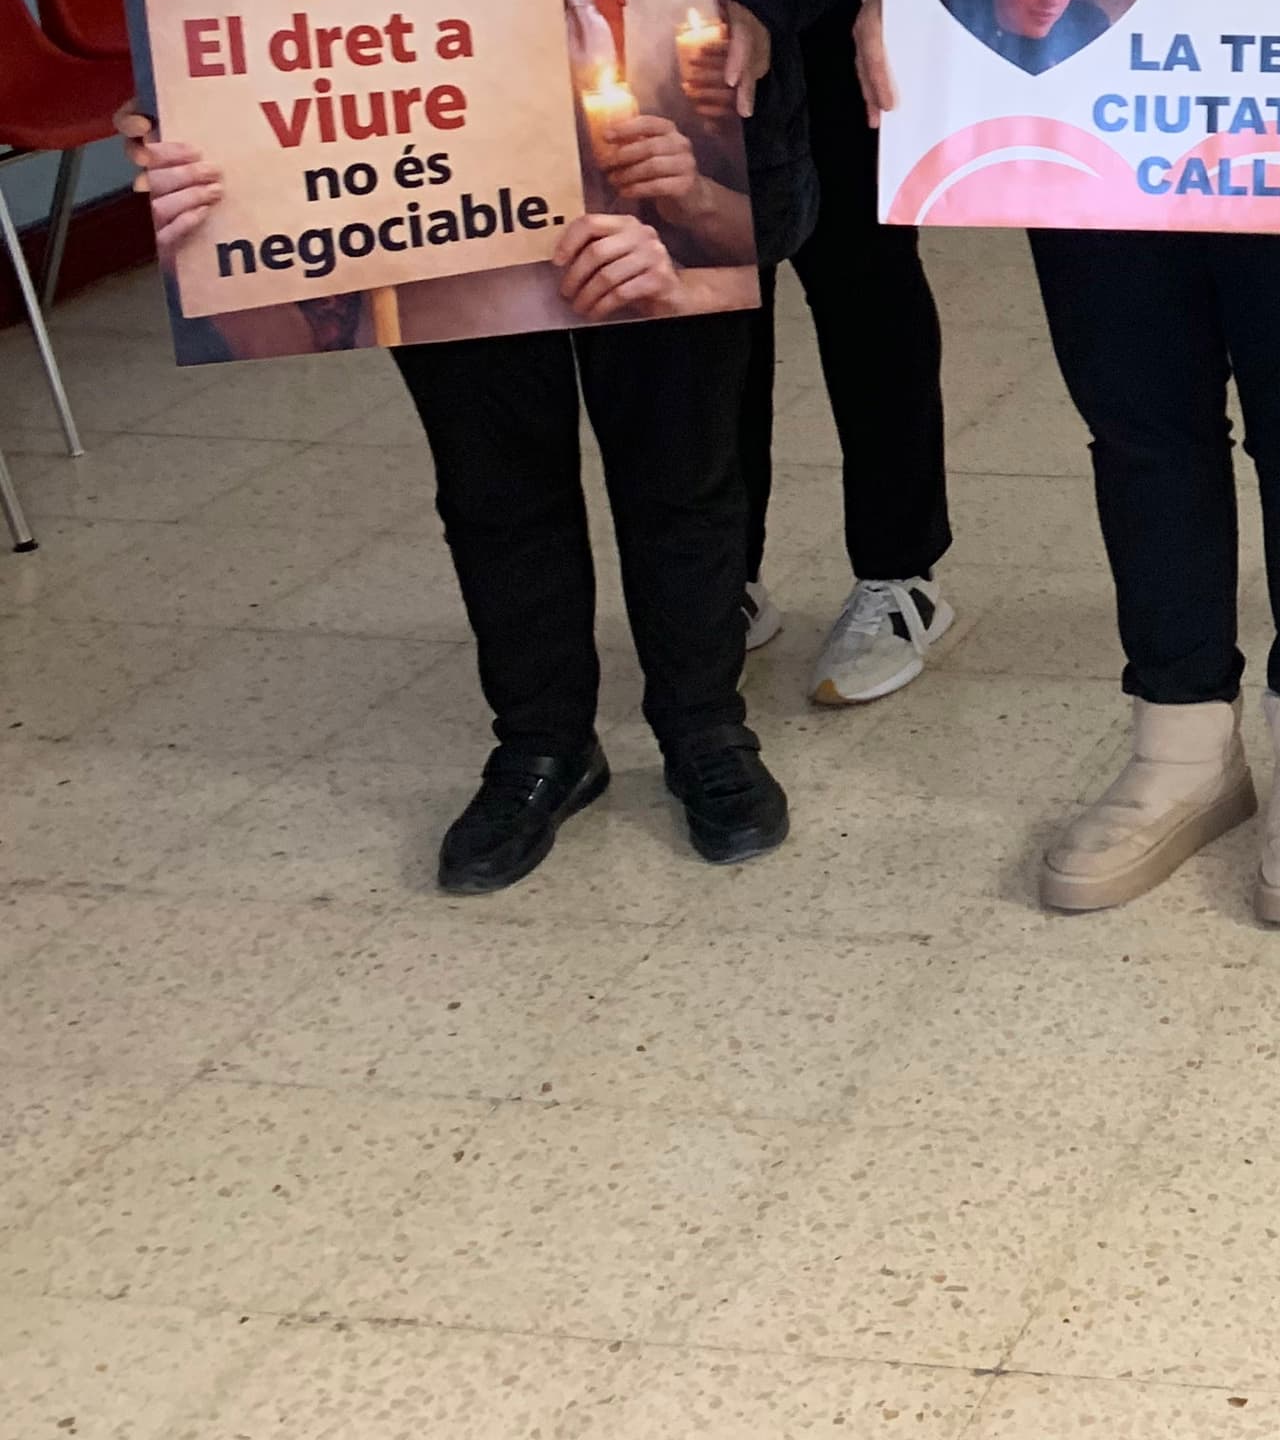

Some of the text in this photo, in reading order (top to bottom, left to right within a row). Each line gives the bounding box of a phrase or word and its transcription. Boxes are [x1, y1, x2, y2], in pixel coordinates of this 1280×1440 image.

[184, 12, 474, 78] El dret a
[1130, 32, 1201, 72] LA
[261, 78, 467, 150] viure
[305, 144, 452, 202] no és
[215, 188, 566, 278] negociable.
